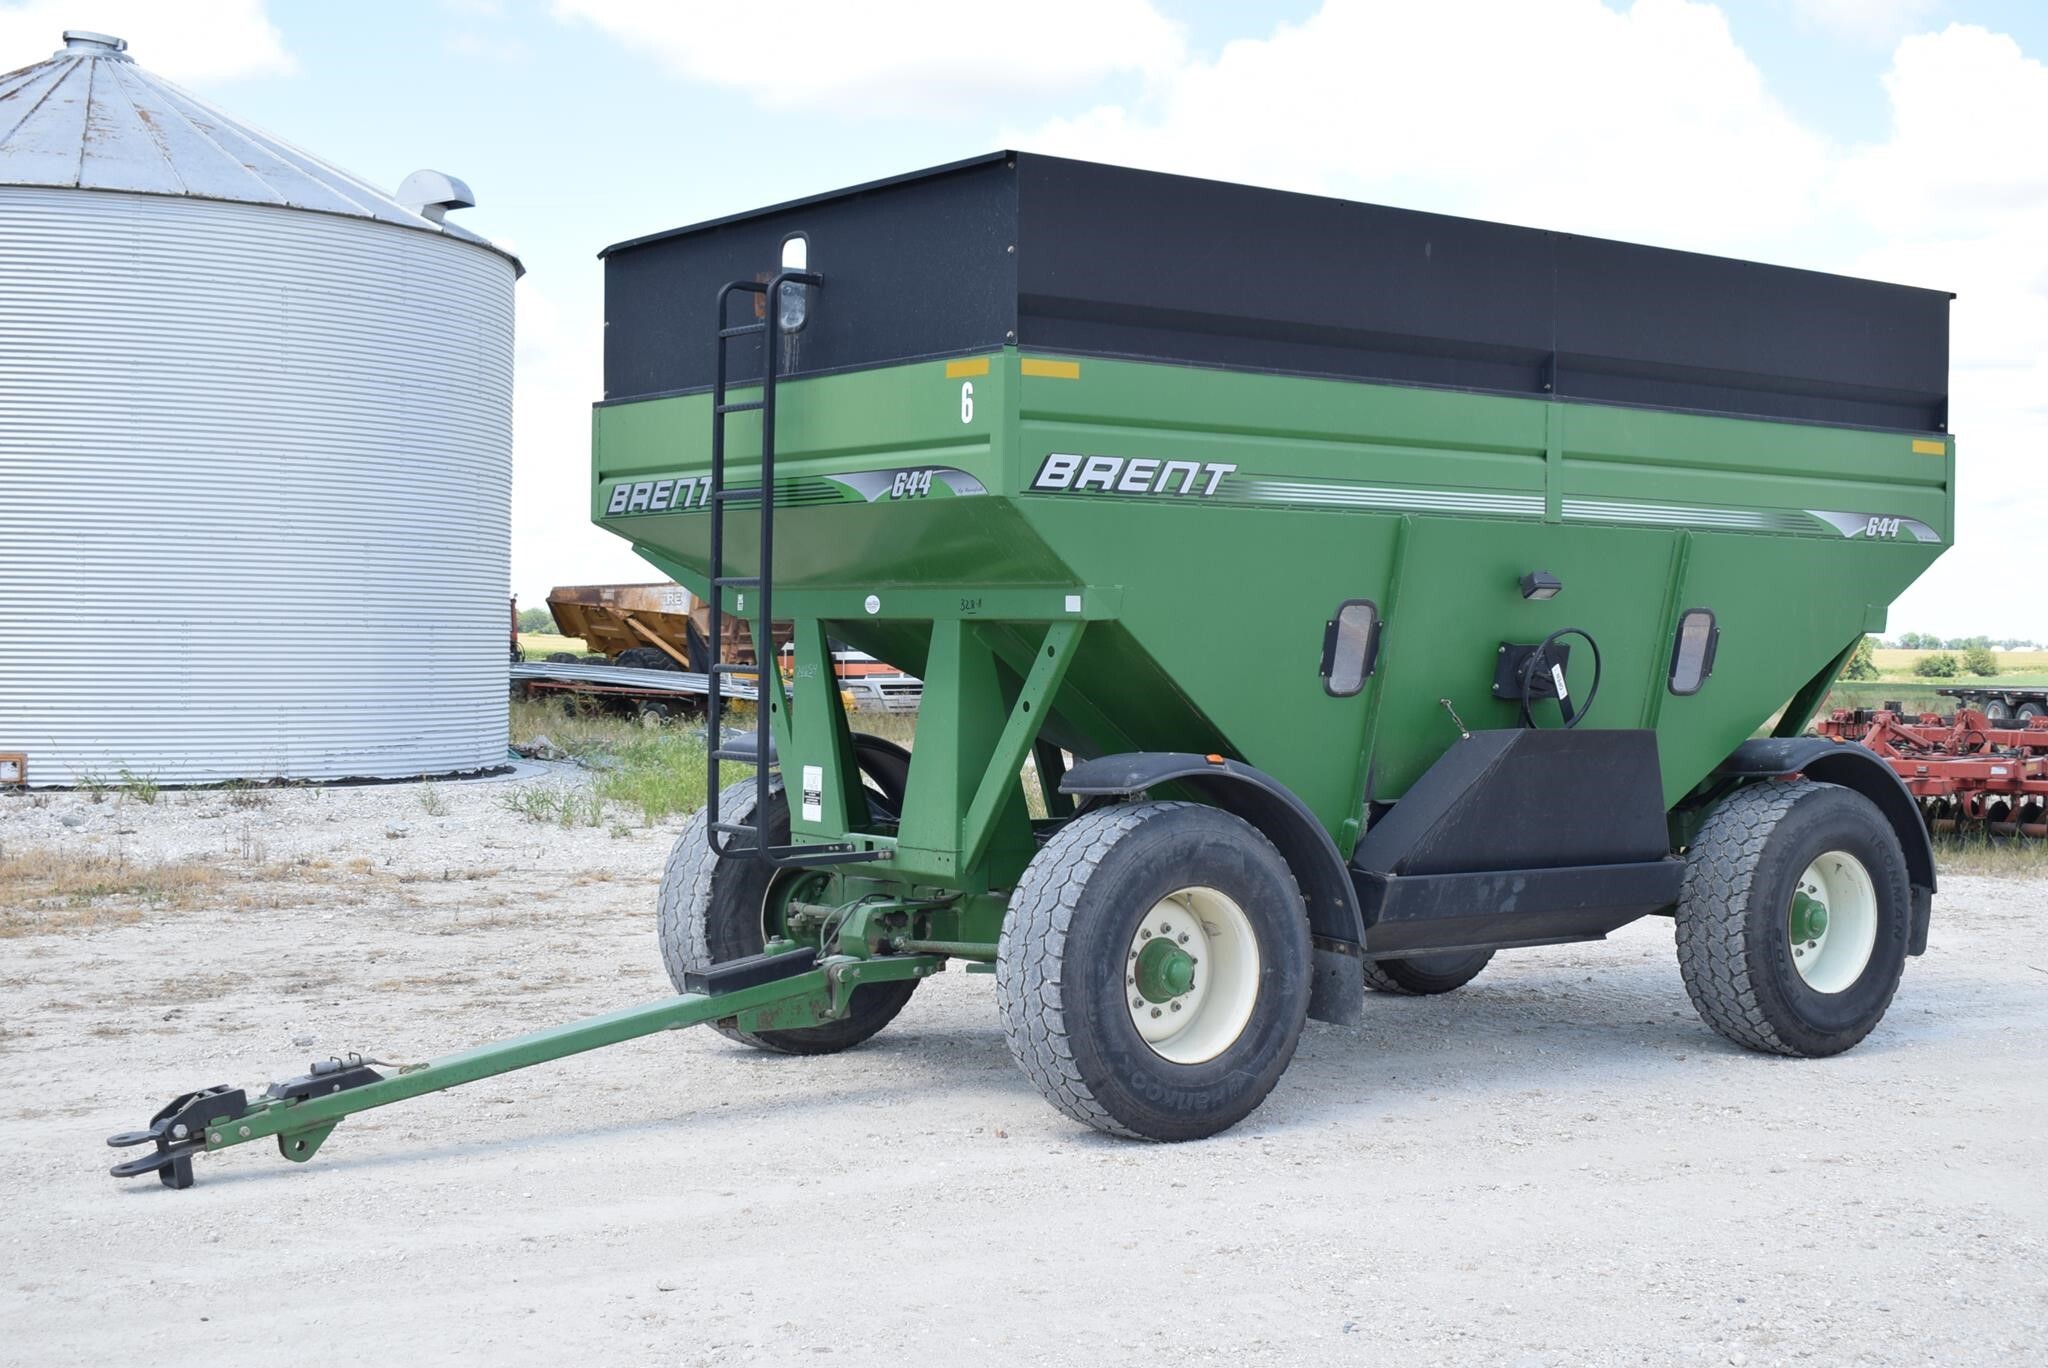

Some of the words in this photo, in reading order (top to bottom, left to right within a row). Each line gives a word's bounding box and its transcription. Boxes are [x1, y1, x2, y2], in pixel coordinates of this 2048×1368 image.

[961, 381, 973, 424] 6
[891, 470, 934, 499] 644
[1031, 453, 1237, 497] BRENT
[1865, 517, 1901, 538] 644
